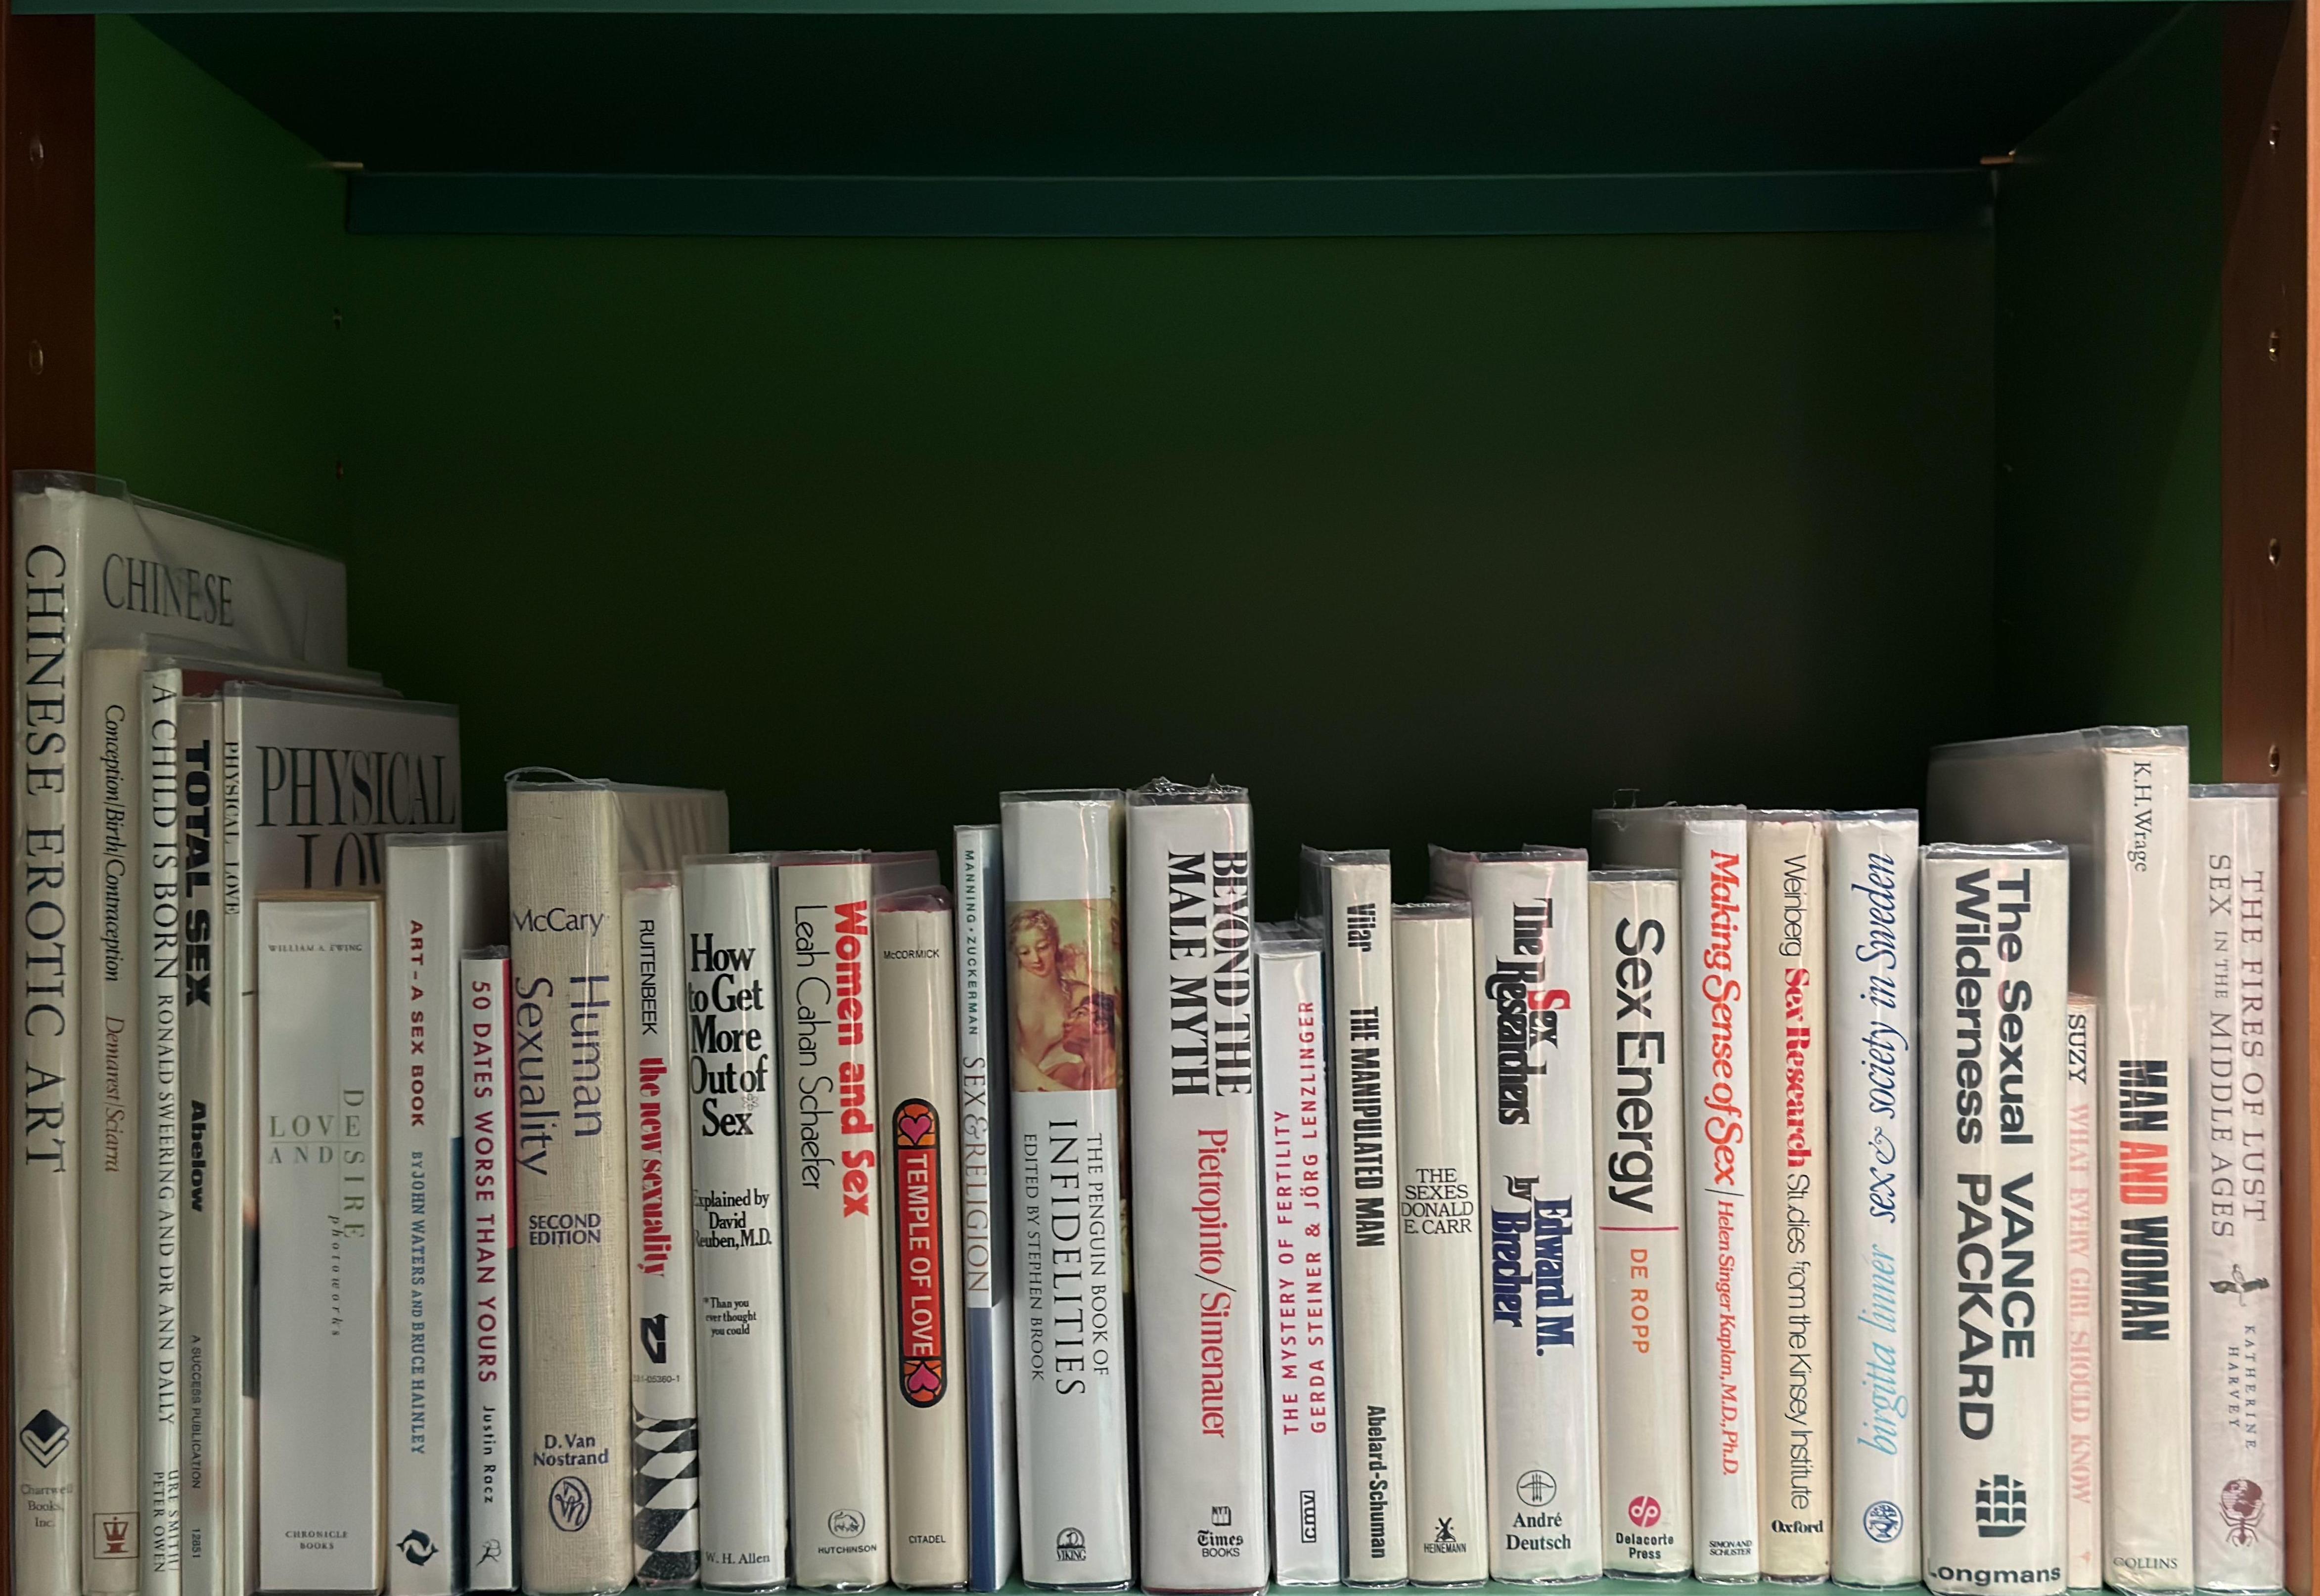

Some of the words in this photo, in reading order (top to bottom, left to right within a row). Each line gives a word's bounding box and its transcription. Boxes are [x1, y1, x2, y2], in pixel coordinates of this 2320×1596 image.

[103, 554, 235, 627] CHINESE
[26, 545, 66, 796] CHINESE
[224, 742, 240, 844] PHYSICAL
[256, 746, 456, 827] PHYSICAL
[2133, 761, 2152, 807] K.H.
[100, 704, 126, 981] Conception/Birth/Contraception
[185, 739, 211, 898] TOTAL
[2127, 809, 2152, 873] Wrage
[224, 862, 240, 915] LOVE
[1167, 850, 1207, 961] MALE
[1778, 854, 1807, 957] Weinberg
[1997, 868, 2031, 963] The
[26, 825, 67, 1037] EROTIC
[410, 920, 424, 966] ART
[514, 907, 604, 937] McCary
[795, 905, 829, 967] Leah
[1212, 850, 1250, 1008] BEYOND
[1347, 903, 1377, 952] Vilar
[185, 909, 212, 1008] SEX
[639, 920, 658, 1035] RUITENBEEK
[690, 932, 756, 972] How
[833, 900, 868, 1046] Women
[1615, 918, 1665, 1021] Sex
[410, 985, 424, 1001] A
[688, 981, 709, 1013] to
[712, 973, 765, 1013] Get
[797, 976, 831, 1065] Cahan
[1785, 968, 1810, 1022] Sex
[1955, 868, 1991, 1145] Wilderness
[410, 1011, 425, 1056] SEX
[690, 1014, 761, 1054] More
[1169, 974, 1210, 1097] MYTH
[1350, 1006, 1380, 1041] THE
[2067, 1014, 2087, 1085] SUZY
[515, 976, 559, 1175] Sexuality
[569, 975, 609, 1138] Human
[639, 1058, 667, 1098] the
[690, 1056, 738, 1095] Out
[739, 1054, 768, 1093] of
[963, 1057, 987, 1108] SEX
[1214, 1013, 1252, 1097] THE
[1298, 1002, 1317, 1139] LENZLINGER
[1997, 979, 2033, 1145] Sexual
[26, 1062, 67, 1174] ART
[410, 1065, 425, 1128] BOOK
[702, 1098, 754, 1137] Sex
[837, 1061, 874, 1136] and
[1351, 1048, 1384, 1190] MANIPULATED
[1608, 1031, 1665, 1214] Energy
[1785, 1026, 1812, 1168] Research
[270, 1115, 361, 1137] LOVE
[640, 1102, 663, 1155] new
[800, 1076, 835, 1190] Schaefer
[964, 1113, 989, 1140] &
[1087, 1133, 1103, 1174] THE
[2068, 1104, 2090, 1172] WHAT
[191, 1100, 207, 1212] Abelow
[268, 1146, 334, 1164] AND
[411, 1151, 423, 1167] BY
[1024, 1134, 1039, 1198] EDITED
[1274, 1110, 1292, 1225] FERTILITY
[1299, 1154, 1319, 1210] JÖRG
[1415, 1168, 1457, 1183] THE
[411, 1170, 425, 1214] JOHN
[754, 1188, 770, 1208] by
[841, 1150, 875, 1218] Sex
[906, 1153, 930, 1251] TEMPLE
[1401, 1201, 1474, 1217] DONALD
[1405, 1184, 1468, 1200] SEXES
[529, 1213, 602, 1230] SECOND
[529, 1230, 602, 1246] EDITION
[636, 1159, 672, 1279] sexuality
[709, 1211, 746, 1230] David
[740, 1228, 773, 1247] M.D.
[965, 1143, 990, 1292] RELIGION
[1026, 1205, 1040, 1226] BY
[1089, 1182, 1107, 1276] PENGUIN
[1305, 1223, 1321, 1238] &
[1355, 1197, 1385, 1247] MAN
[1404, 1219, 1419, 1234] E.
[1422, 1218, 1473, 1234] CARR
[1786, 1173, 1811, 1254] Studies
[2068, 1188, 2091, 1258] EVERY
[328, 1215, 344, 1336] photoworks
[411, 1220, 425, 1286] WATERS
[910, 1257, 931, 1288] OF
[1028, 1231, 1043, 1310] STEPHEN
[1048, 1119, 1086, 1395] INFIDELITIES
[1277, 1239, 1294, 1264] OF
[1630, 1248, 1648, 1279] DE
[2000, 1172, 2035, 1359] VANCE
[411, 1289, 423, 1317] AND
[1305, 1252, 1324, 1346] STEINER
[1788, 1261, 1812, 1308] from
[1956, 1173, 1994, 1441] PACKARD
[2069, 1267, 2091, 1323] GIRL
[192, 1334, 201, 1343] A
[910, 1295, 934, 1356] LOVE
[1091, 1285, 1108, 1344] BOOK
[1278, 1278, 1298, 1379] MYSTERY
[1631, 1288, 1650, 1354] ROPP
[1788, 1314, 1812, 1348] the
[192, 1347, 201, 1404] SUCCESS
[411, 1321, 425, 1374] BRUCE
[1031, 1318, 1044, 1381] BROOK
[1093, 1349, 1109, 1376] OF
[1308, 1360, 1327, 1434] GERDA
[1784, 1354, 1812, 1425] Kinsey
[2069, 1330, 2091, 1423] SHOULD
[2228, 1346, 2239, 1428] HARVEY
[2244, 1325, 2257, 1450] KATHERINE
[411, 1380, 425, 1455] HAINLEY
[483, 1405, 497, 1455] Justin
[544, 1434, 562, 1450] D.
[565, 1433, 595, 1448] Van
[1282, 1393, 1299, 1436] THE
[192, 1408, 201, 1489] PUBLICATION
[533, 1449, 610, 1466] Nostrand
[1789, 1430, 1815, 1509] Institute
[2070, 1433, 2092, 1504] KNOW
[153, 1471, 165, 1518] PETER
[484, 1464, 497, 1504] Racz
[1367, 1405, 1388, 1559] Abelard-Schuman
[285, 1530, 349, 1539] CHRONICLE
[909, 1535, 946, 1544] CITADEL
[1197, 1530, 1244, 1546] Times
[1505, 1534, 1571, 1551] Deutsch
[1512, 1511, 1563, 1527] André
[1616, 1532, 1674, 1545] Delacorte
[1771, 1519, 1823, 1534] Oxford
[153, 1525, 165, 1572] OWEN
[722, 1553, 735, 1564] H.
[738, 1552, 771, 1564] Allen
[818, 1544, 877, 1554] HUTCHINSON
[1056, 1550, 1087, 1561] VIKING
[1202, 1548, 1240, 1557] BOOKS
[1424, 1543, 1466, 1553] HEINEMANN
[1629, 1547, 1661, 1559] Press
[2113, 1557, 2179, 1569] COLLINS
[1930, 1566, 2061, 1587] ongmans
